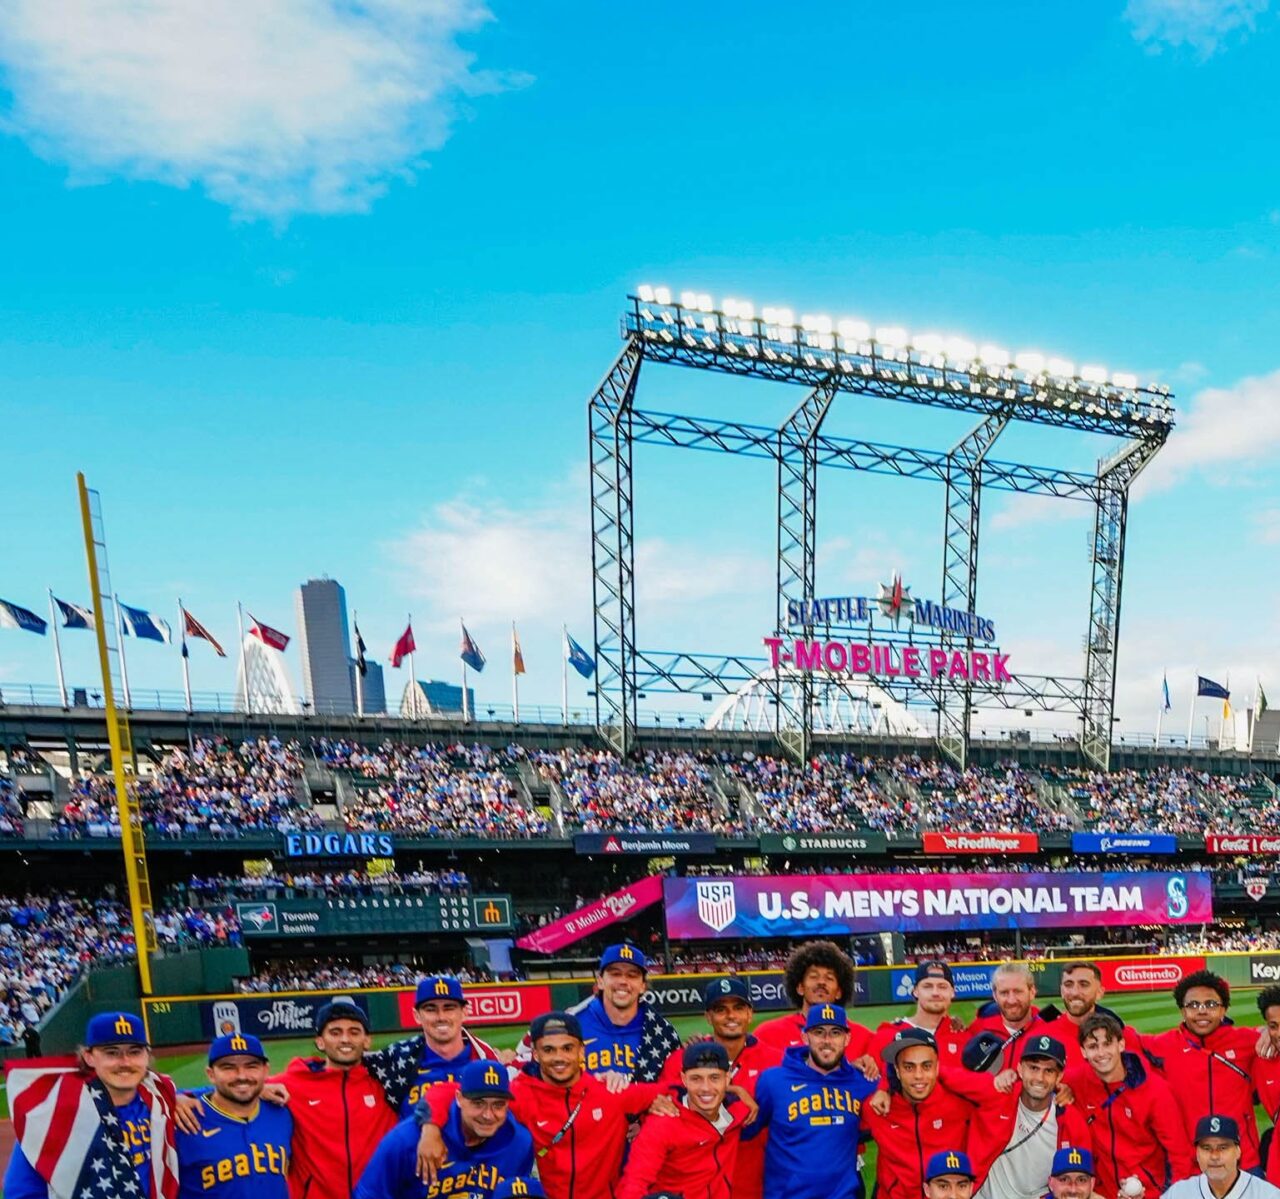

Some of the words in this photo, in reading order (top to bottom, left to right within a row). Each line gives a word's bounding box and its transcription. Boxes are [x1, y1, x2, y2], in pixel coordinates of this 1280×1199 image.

[786, 597, 869, 627] SEATTLE
[914, 599, 996, 643] MARINERS
[763, 637, 923, 678] T-MOBILE
[929, 649, 1013, 683] PARK
[286, 832, 394, 857] EDGARS
[621, 840, 662, 854] Benjamin
[662, 840, 690, 851] Moore
[799, 838, 867, 849] STARBUCKS
[1113, 838, 1151, 848] BOEING
[700, 886, 731, 902] USA
[1250, 885, 1263, 895] 42
[576, 906, 608, 930] Mobile
[606, 892, 637, 917] Pen
[758, 892, 820, 921] U.S.
[824, 888, 920, 919] MEN'S
[925, 886, 1067, 917] NATIONAL
[1070, 886, 1143, 912] TEAM
[282, 911, 320, 922] Toronto
[440, 908, 448, 918] 0
[451, 908, 459, 917] 0
[462, 907, 469, 917] 0
[283, 923, 316, 933] Seattle
[442, 919, 449, 929] 0
[452, 919, 460, 929] 0
[463, 919, 470, 928] 0
[956, 972, 987, 983] Mason
[1121, 968, 1176, 980] Nintendo
[971, 981, 993, 992] Heal
[644, 988, 703, 1004] OYOTA
[152, 1002, 172, 1014] 331
[216, 1007, 236, 1019] Lite
[581, 1043, 637, 1071] eatt
[788, 1087, 861, 1121] seattle
[202, 1143, 289, 1189] seattl
